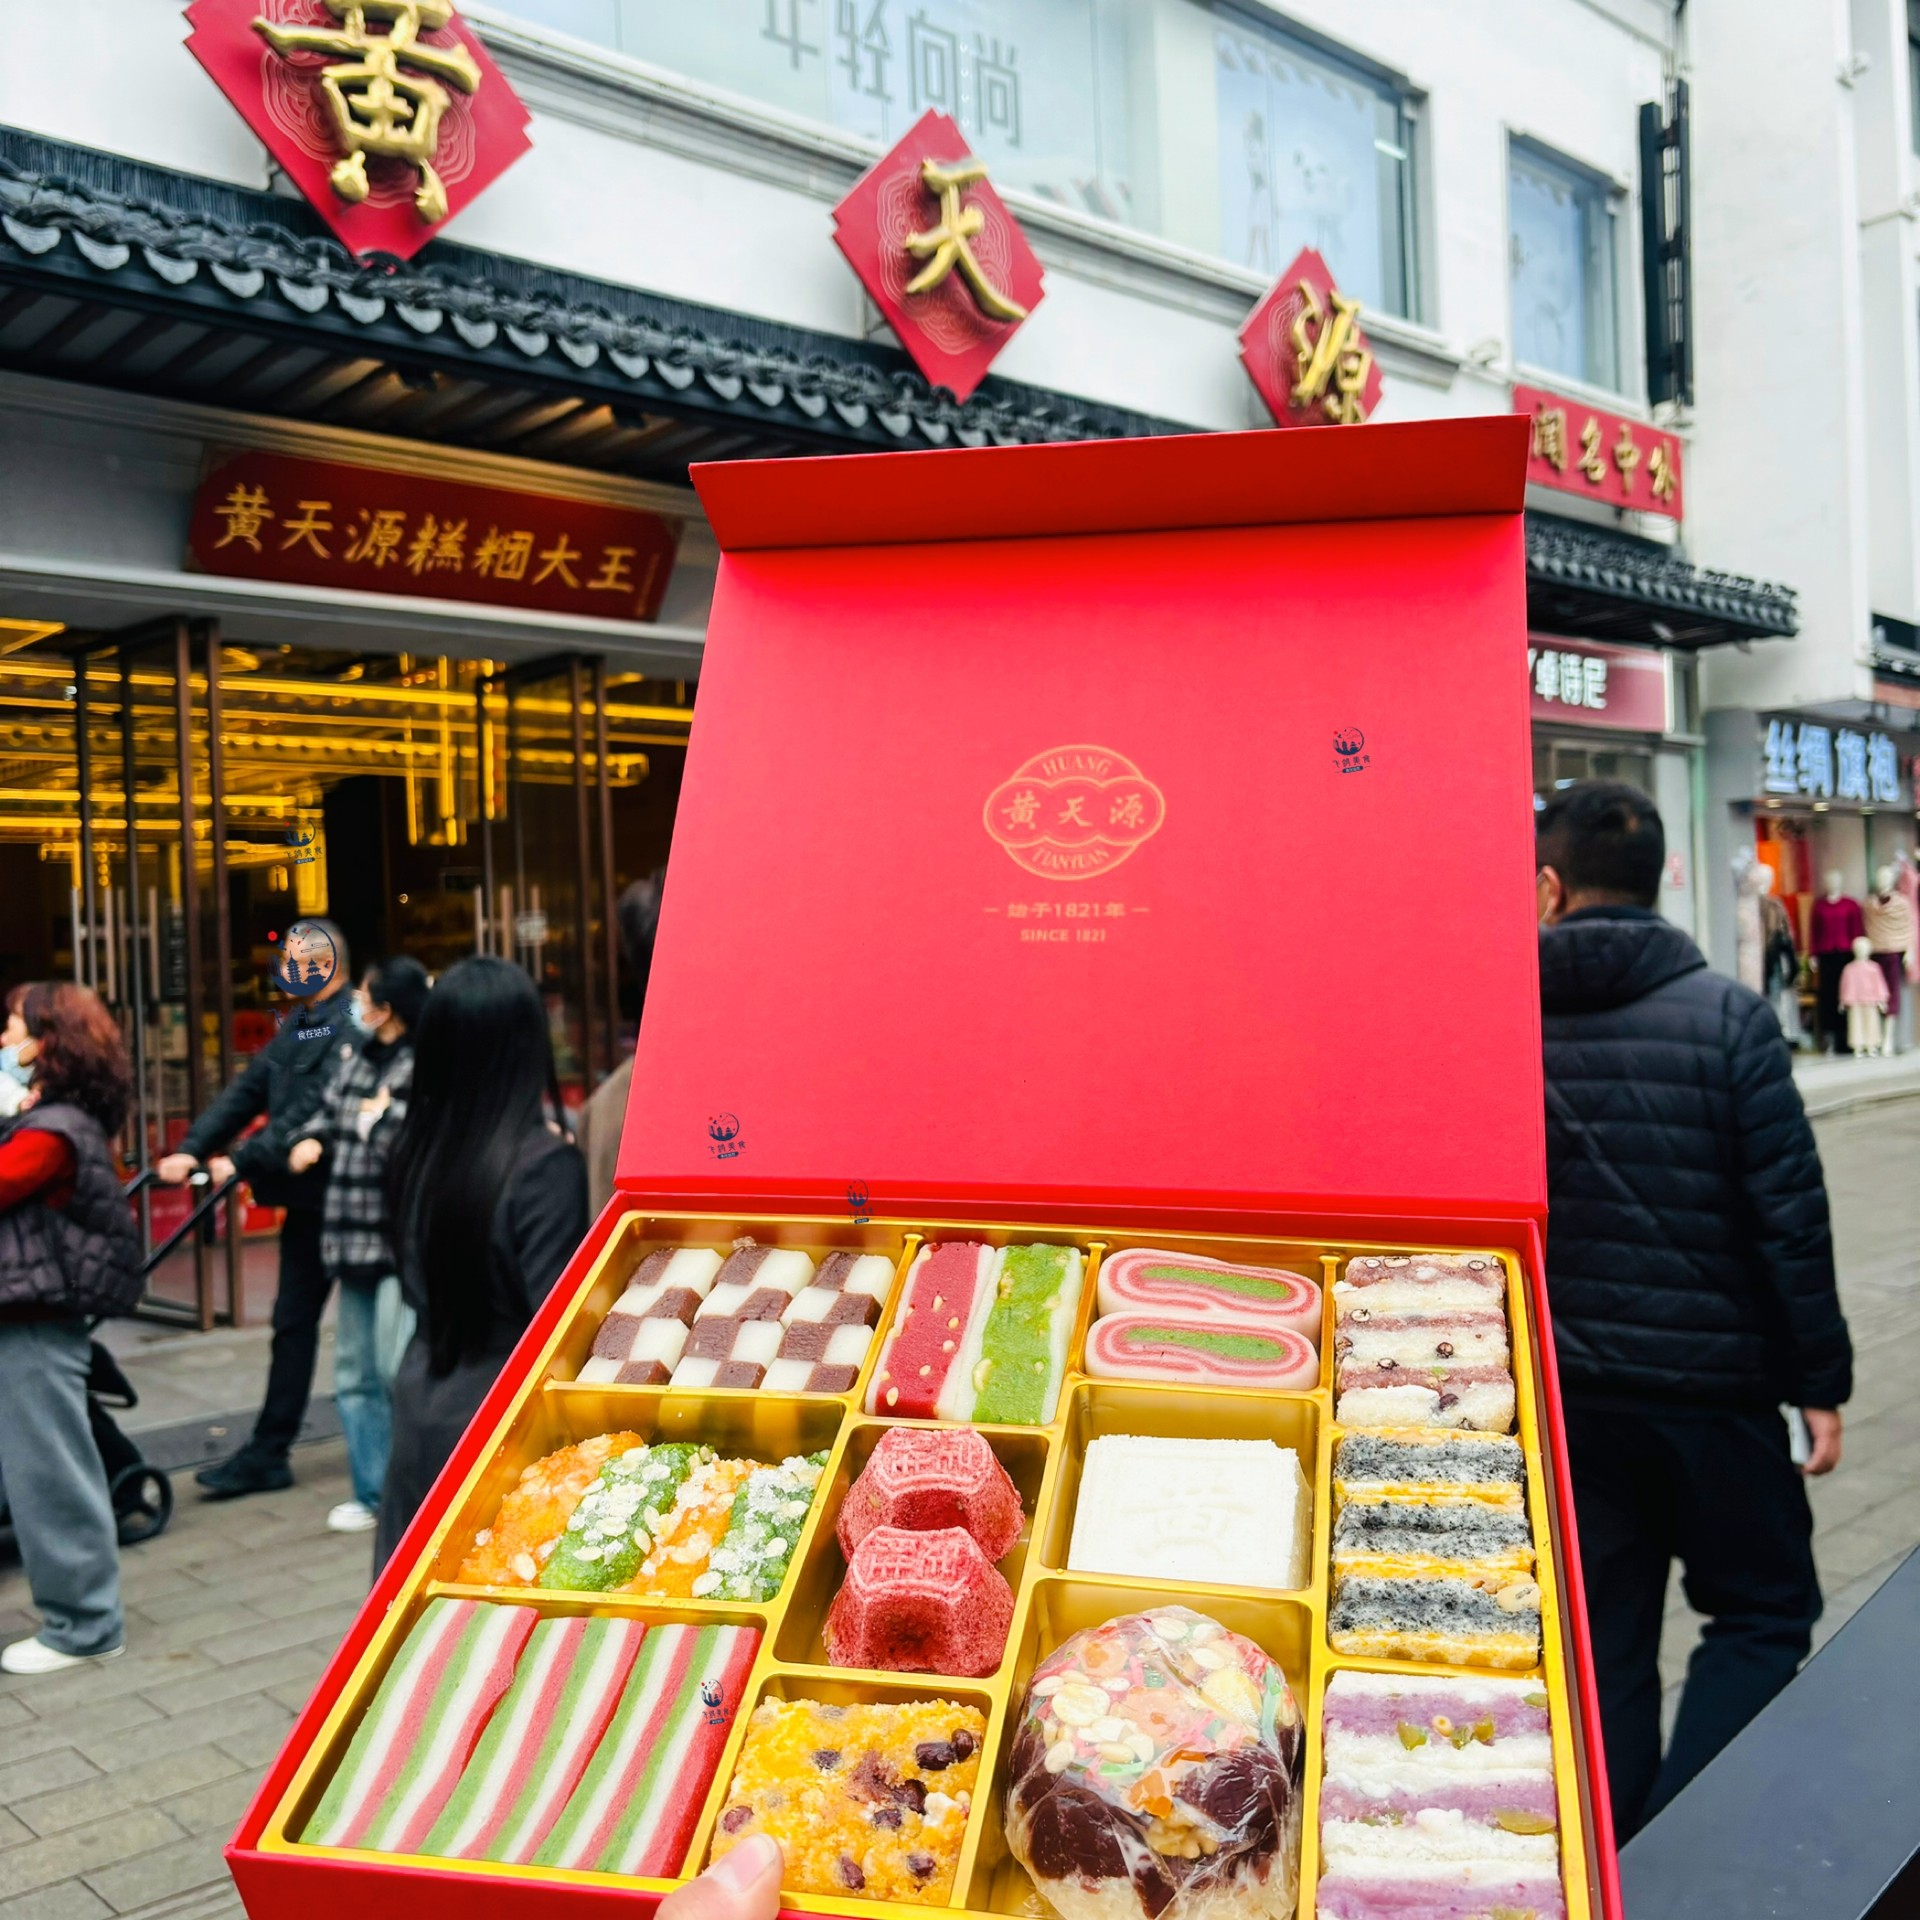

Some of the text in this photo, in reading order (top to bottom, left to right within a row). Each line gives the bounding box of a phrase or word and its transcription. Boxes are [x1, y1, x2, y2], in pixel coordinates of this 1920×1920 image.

[905, 156, 1029, 323] 天
[1289, 276, 1375, 424] 源
[1042, 755, 1113, 776] HUANG
[1764, 719, 1900, 802] 丝绸旗袍
[1001, 789, 1146, 831] 黄天源
[1020, 929, 1106, 942] SINCE 1821
